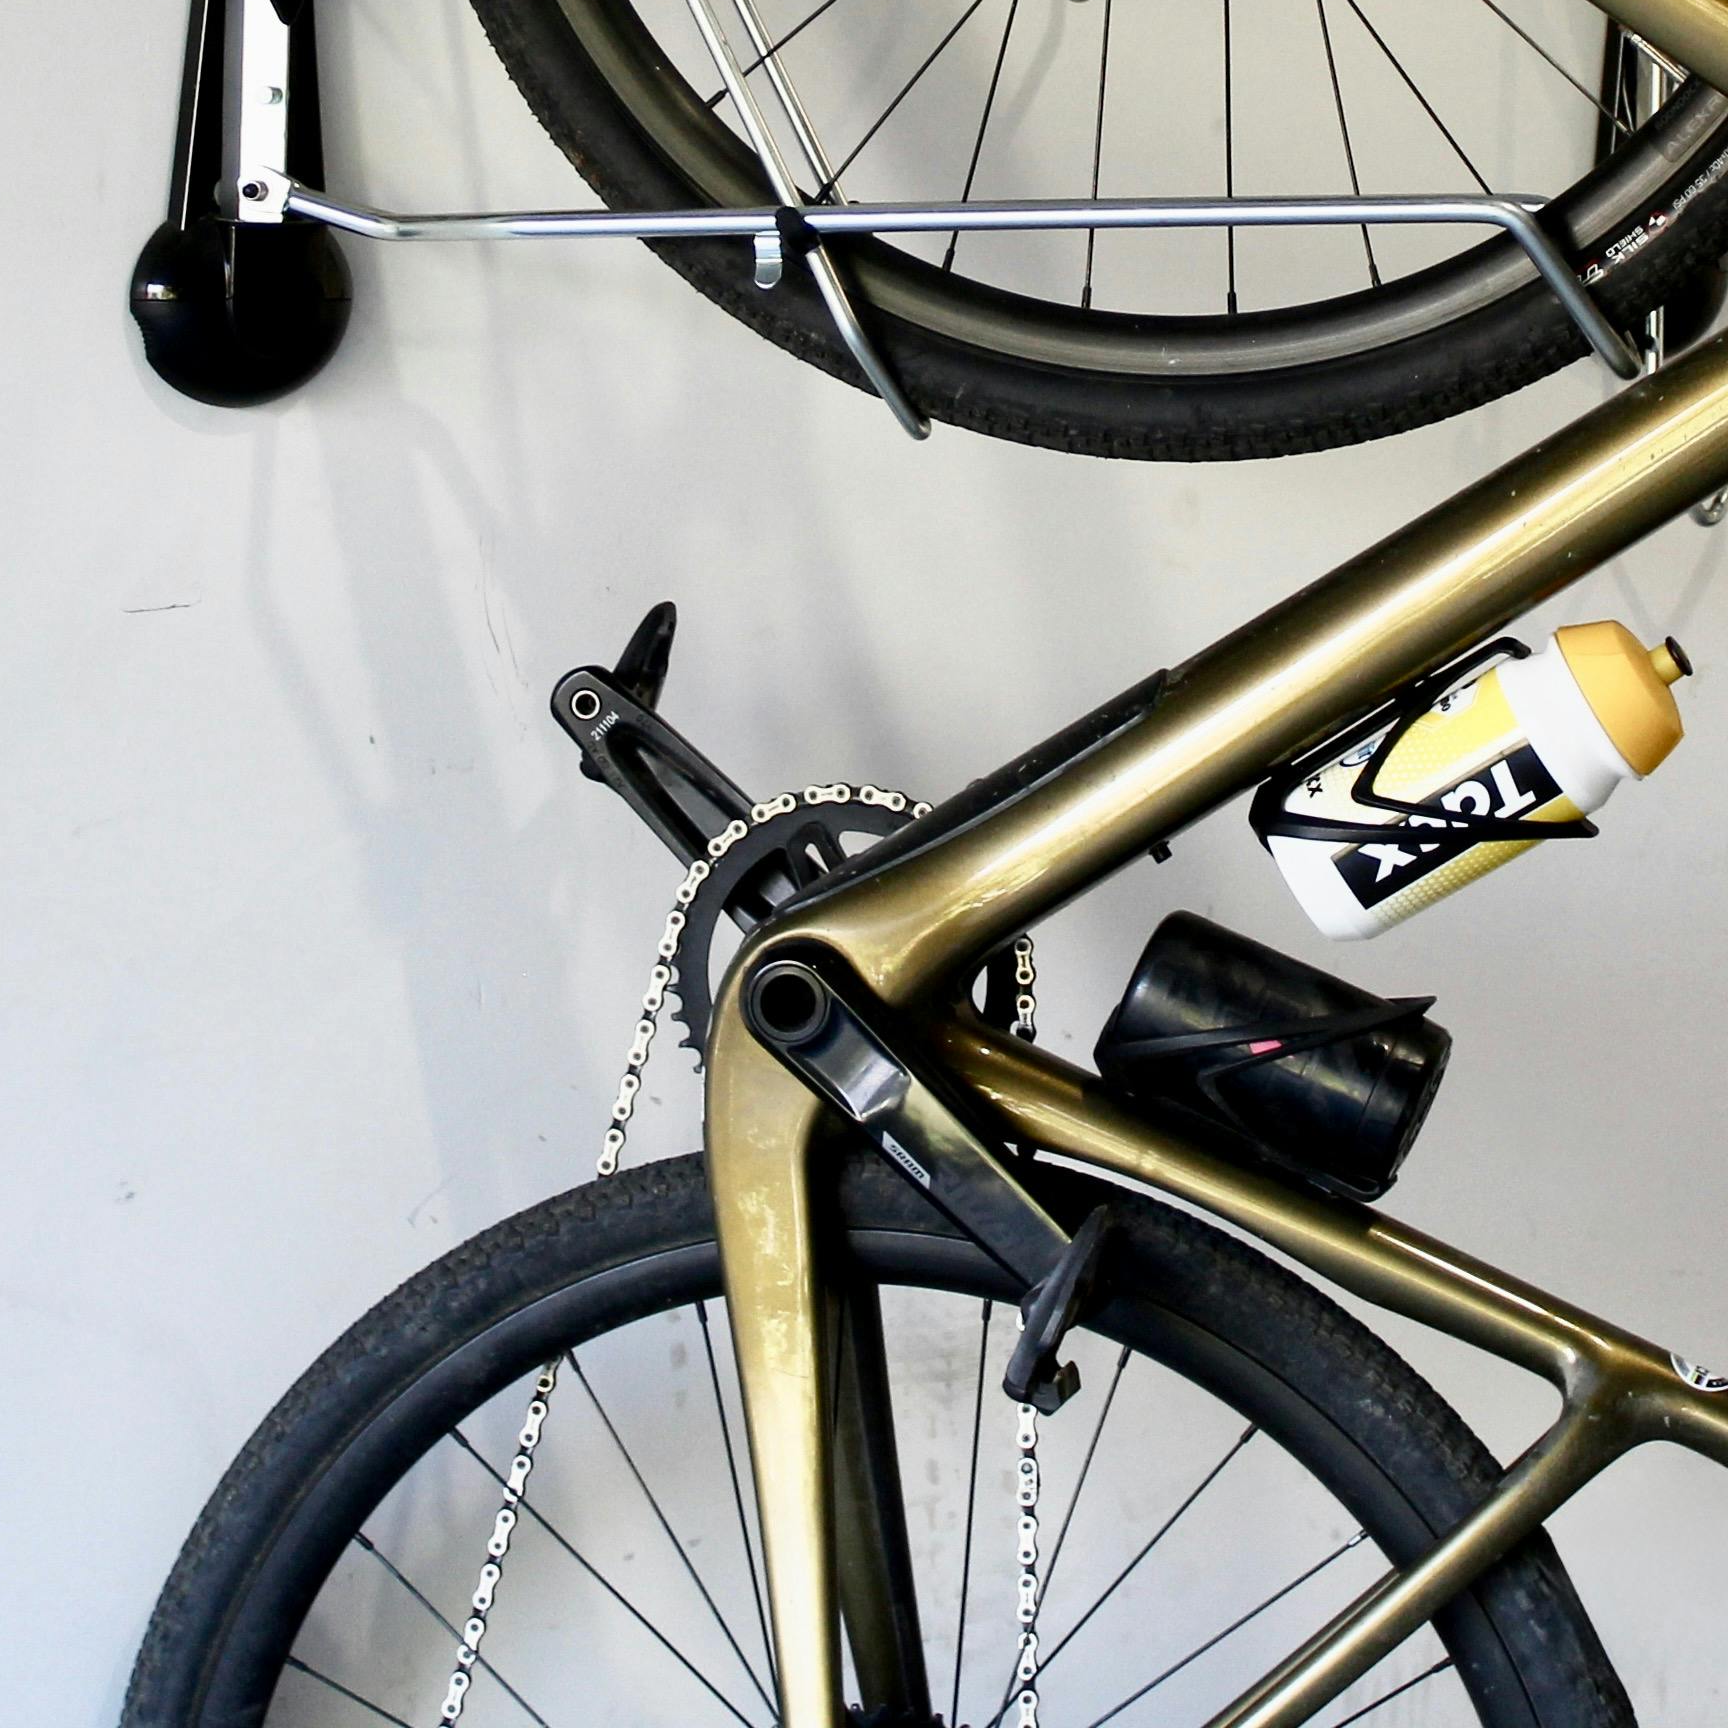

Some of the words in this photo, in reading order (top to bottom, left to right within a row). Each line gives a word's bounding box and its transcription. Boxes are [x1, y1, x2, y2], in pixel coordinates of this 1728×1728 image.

[1605, 225, 1645, 259] SHIELD
[1609, 234, 1649, 265] SILK
[590, 711, 620, 741] 211104
[890, 1144, 925, 1179] SRAM
